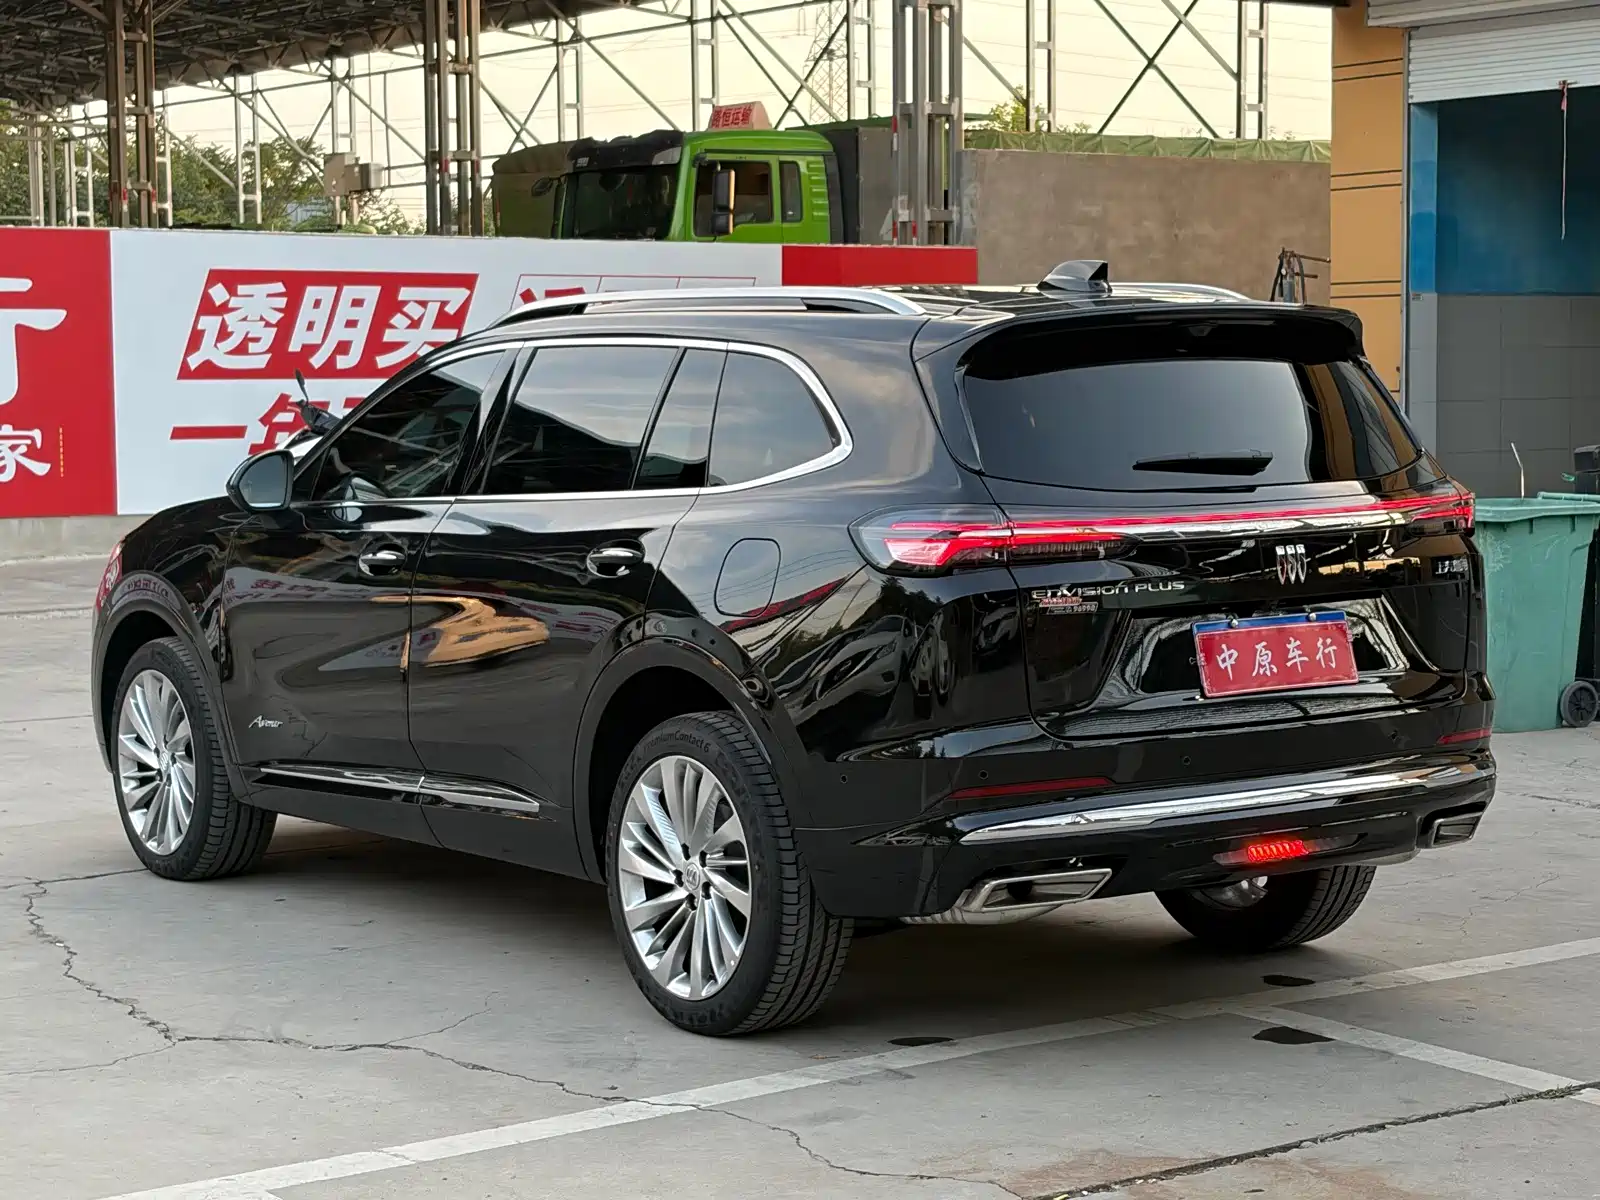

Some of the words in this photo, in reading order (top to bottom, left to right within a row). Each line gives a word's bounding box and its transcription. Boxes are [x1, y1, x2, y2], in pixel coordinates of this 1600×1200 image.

[187, 281, 472, 371] 透明买
[169, 392, 366, 455] 一年
[1134, 580, 1185, 592] PLUS
[1216, 636, 1337, 681] 中原车行
